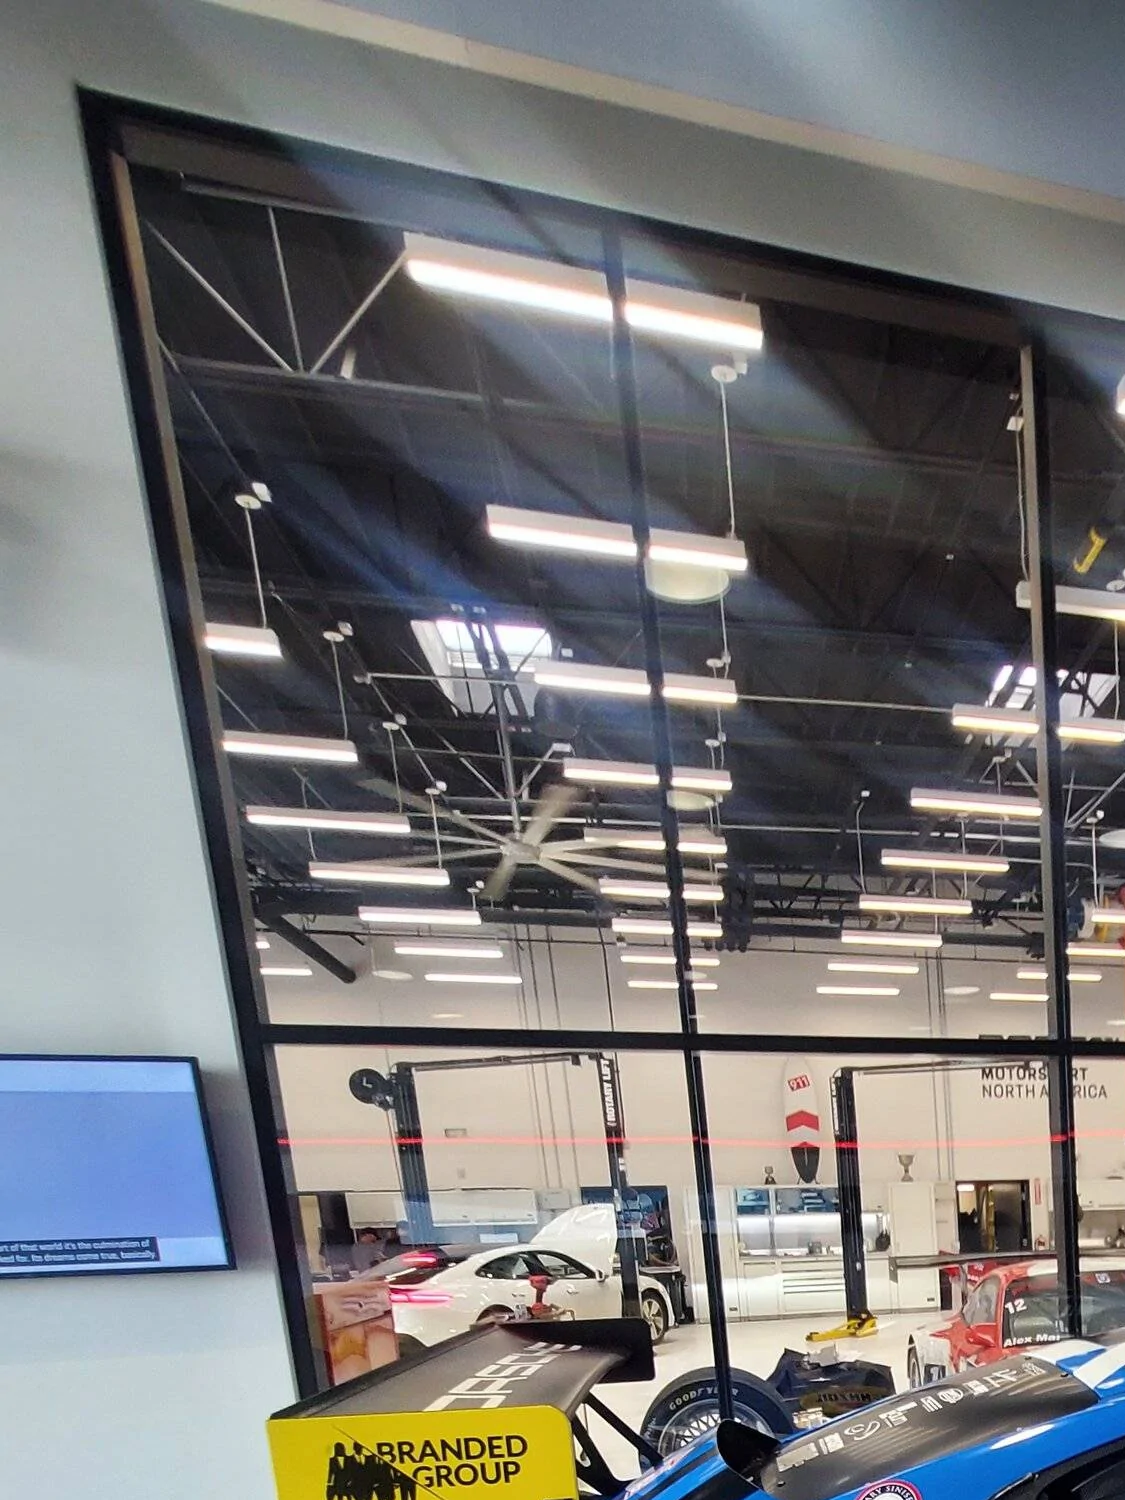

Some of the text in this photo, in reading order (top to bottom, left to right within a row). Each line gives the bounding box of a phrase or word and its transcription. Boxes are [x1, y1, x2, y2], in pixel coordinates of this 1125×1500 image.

[981, 1067, 1089, 1081] MOTORSRT
[789, 1076, 810, 1091] 911
[982, 1084, 1108, 1099] NORTH ARICA
[1005, 1298, 1027, 1314] 12
[1004, 1336, 1033, 1348] Alex
[375, 1435, 528, 1465] BRANDED
[412, 1461, 521, 1489] GROUP
